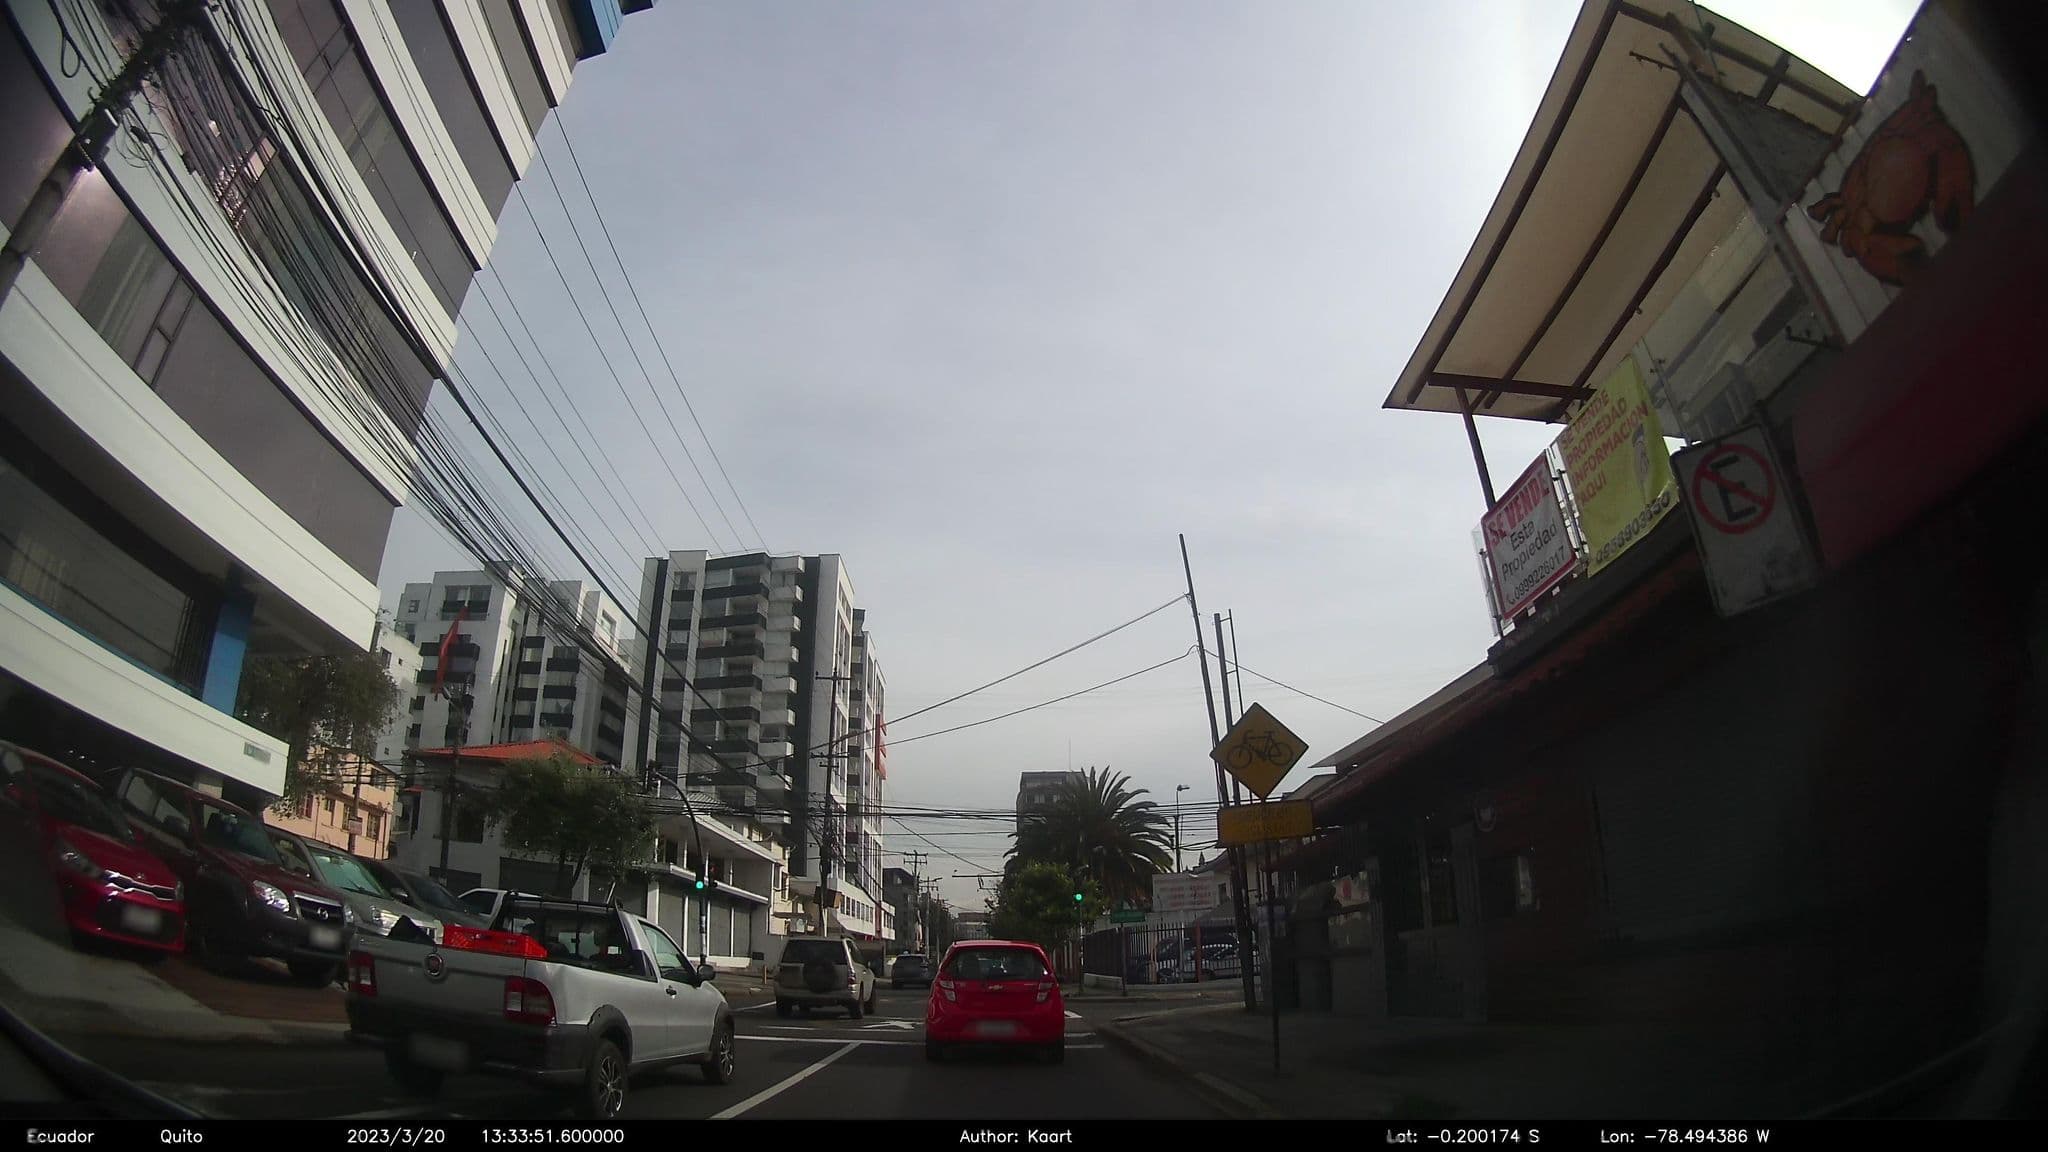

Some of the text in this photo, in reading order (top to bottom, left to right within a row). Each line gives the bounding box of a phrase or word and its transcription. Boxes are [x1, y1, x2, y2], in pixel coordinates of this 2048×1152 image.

[1566, 397, 1628, 469] PROPIEDAD
[1574, 389, 1610, 434] VENDE
[1487, 470, 1550, 547] SE VENDE
[1510, 520, 1535, 551] Esta
[1501, 521, 1558, 582] Propiedad
[1514, 545, 1566, 600] 0999226017
